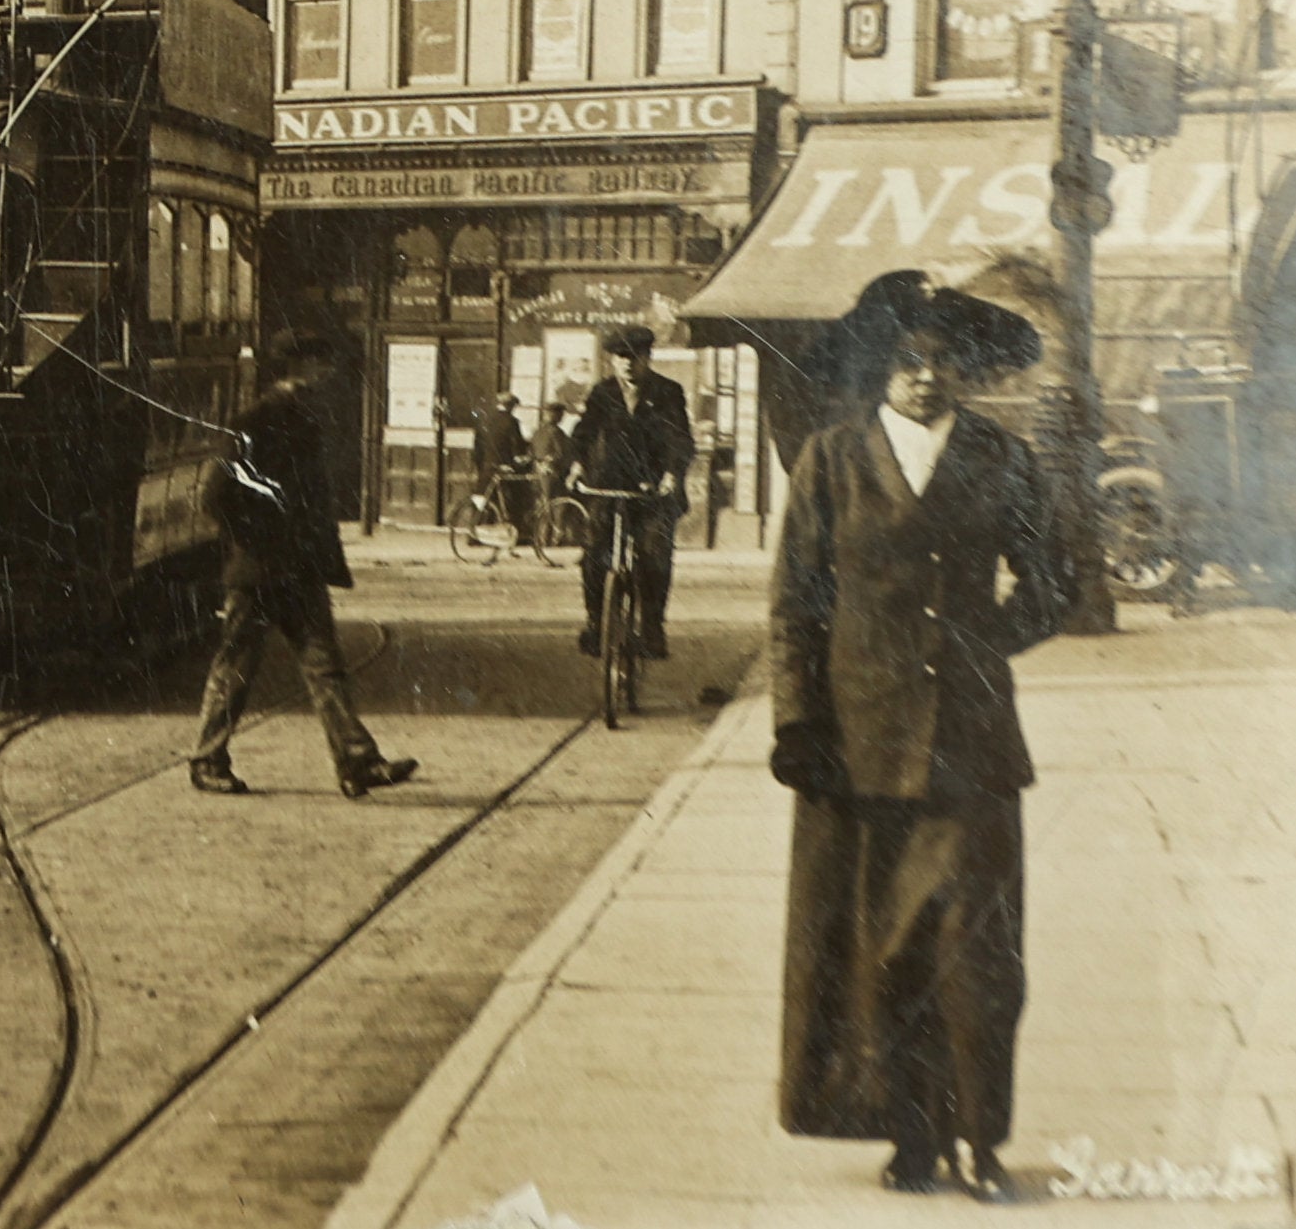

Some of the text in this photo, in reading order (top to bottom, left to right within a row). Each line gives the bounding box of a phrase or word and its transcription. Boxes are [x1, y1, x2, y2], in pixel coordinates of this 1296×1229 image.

[277, 94, 734, 143] NADIAN PACIFIC
[266, 175, 310, 200] The
[332, 171, 455, 197] Canadian
[471, 169, 565, 196] Pacific
